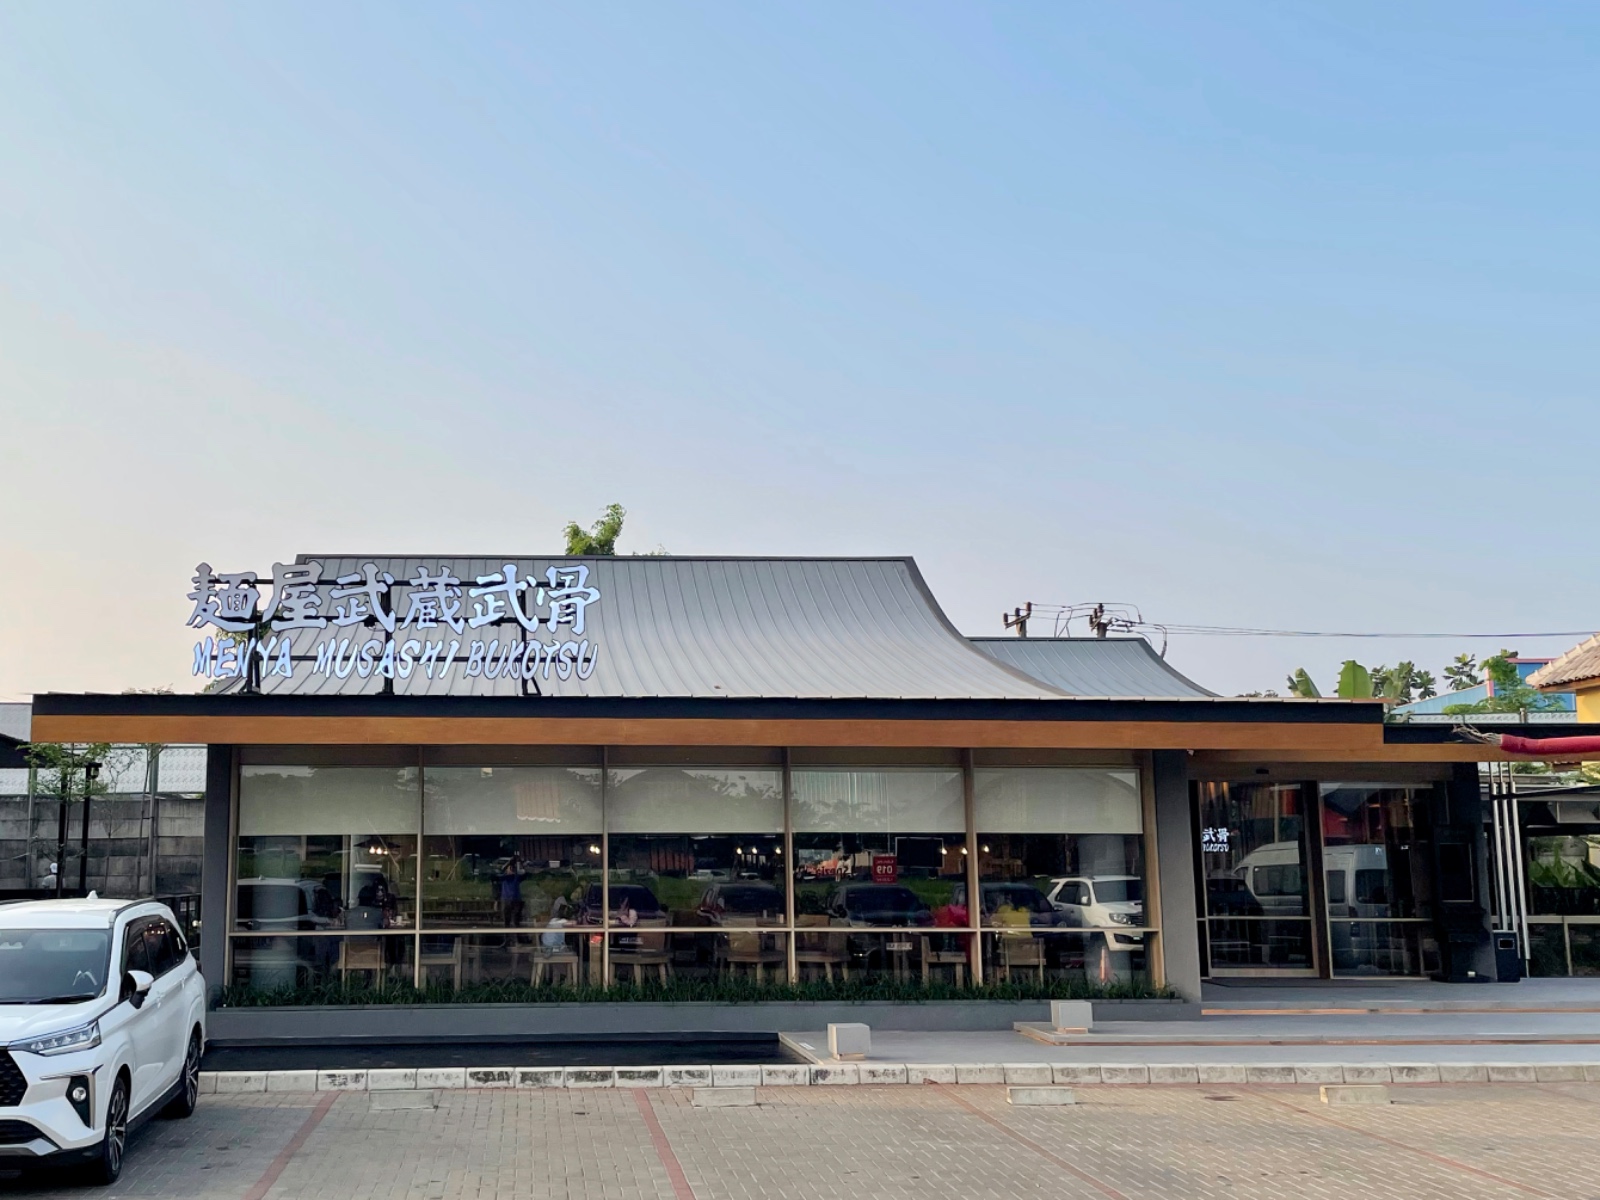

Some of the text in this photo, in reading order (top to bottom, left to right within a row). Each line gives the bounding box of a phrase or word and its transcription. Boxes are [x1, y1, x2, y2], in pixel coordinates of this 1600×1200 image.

[186, 562, 601, 635] 麺屋武蔵武骨
[192, 636, 598, 681] MENYA MUSASHI BUKOTSU
